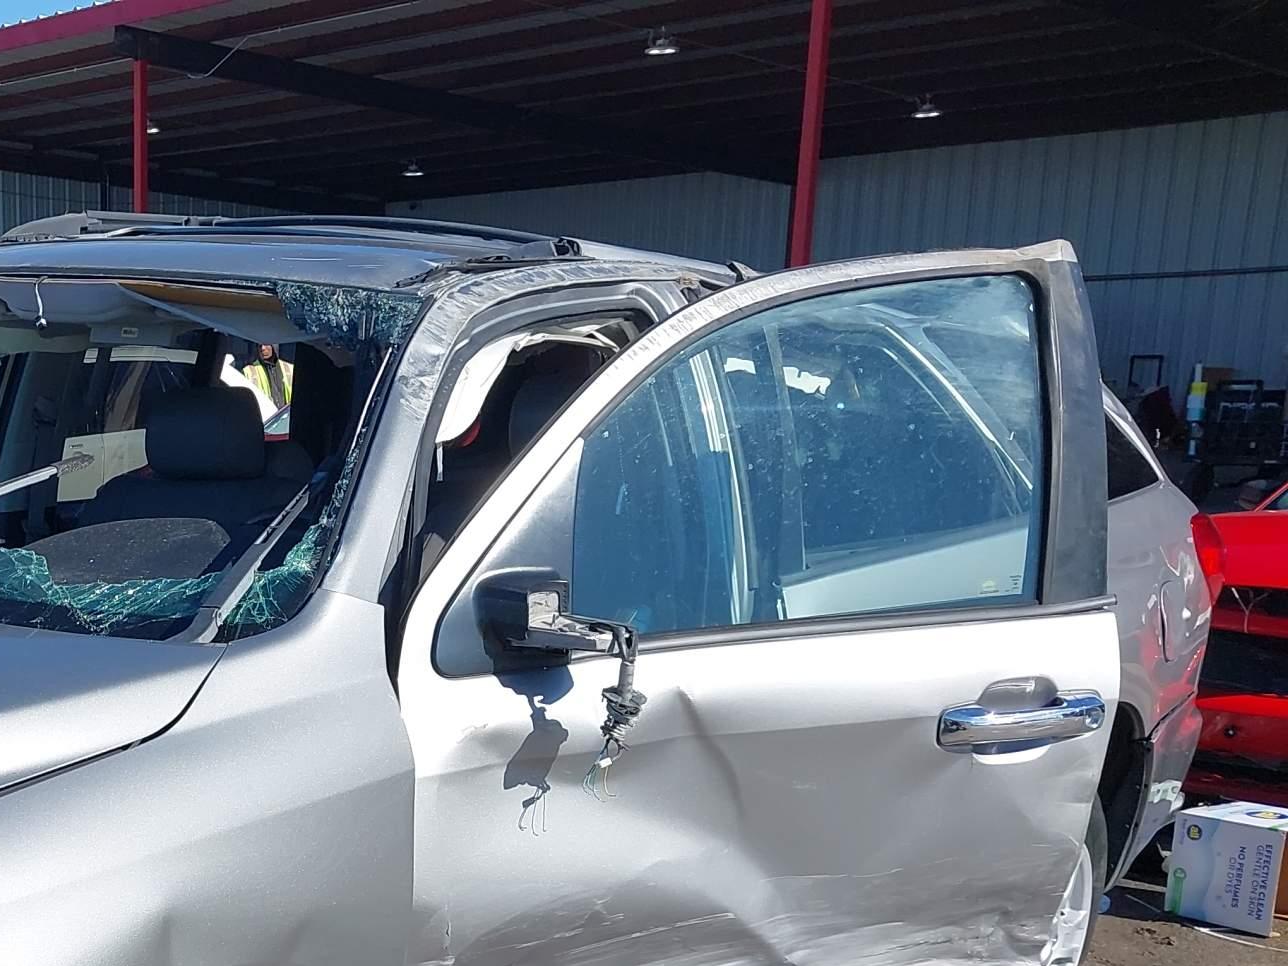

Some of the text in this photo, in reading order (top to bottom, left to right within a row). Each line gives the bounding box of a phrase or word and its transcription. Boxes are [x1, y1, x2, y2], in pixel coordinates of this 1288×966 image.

[1230, 846, 1246, 909] NO PERFUMES
[1255, 844, 1273, 921] EFFECTIVE CLEAN
